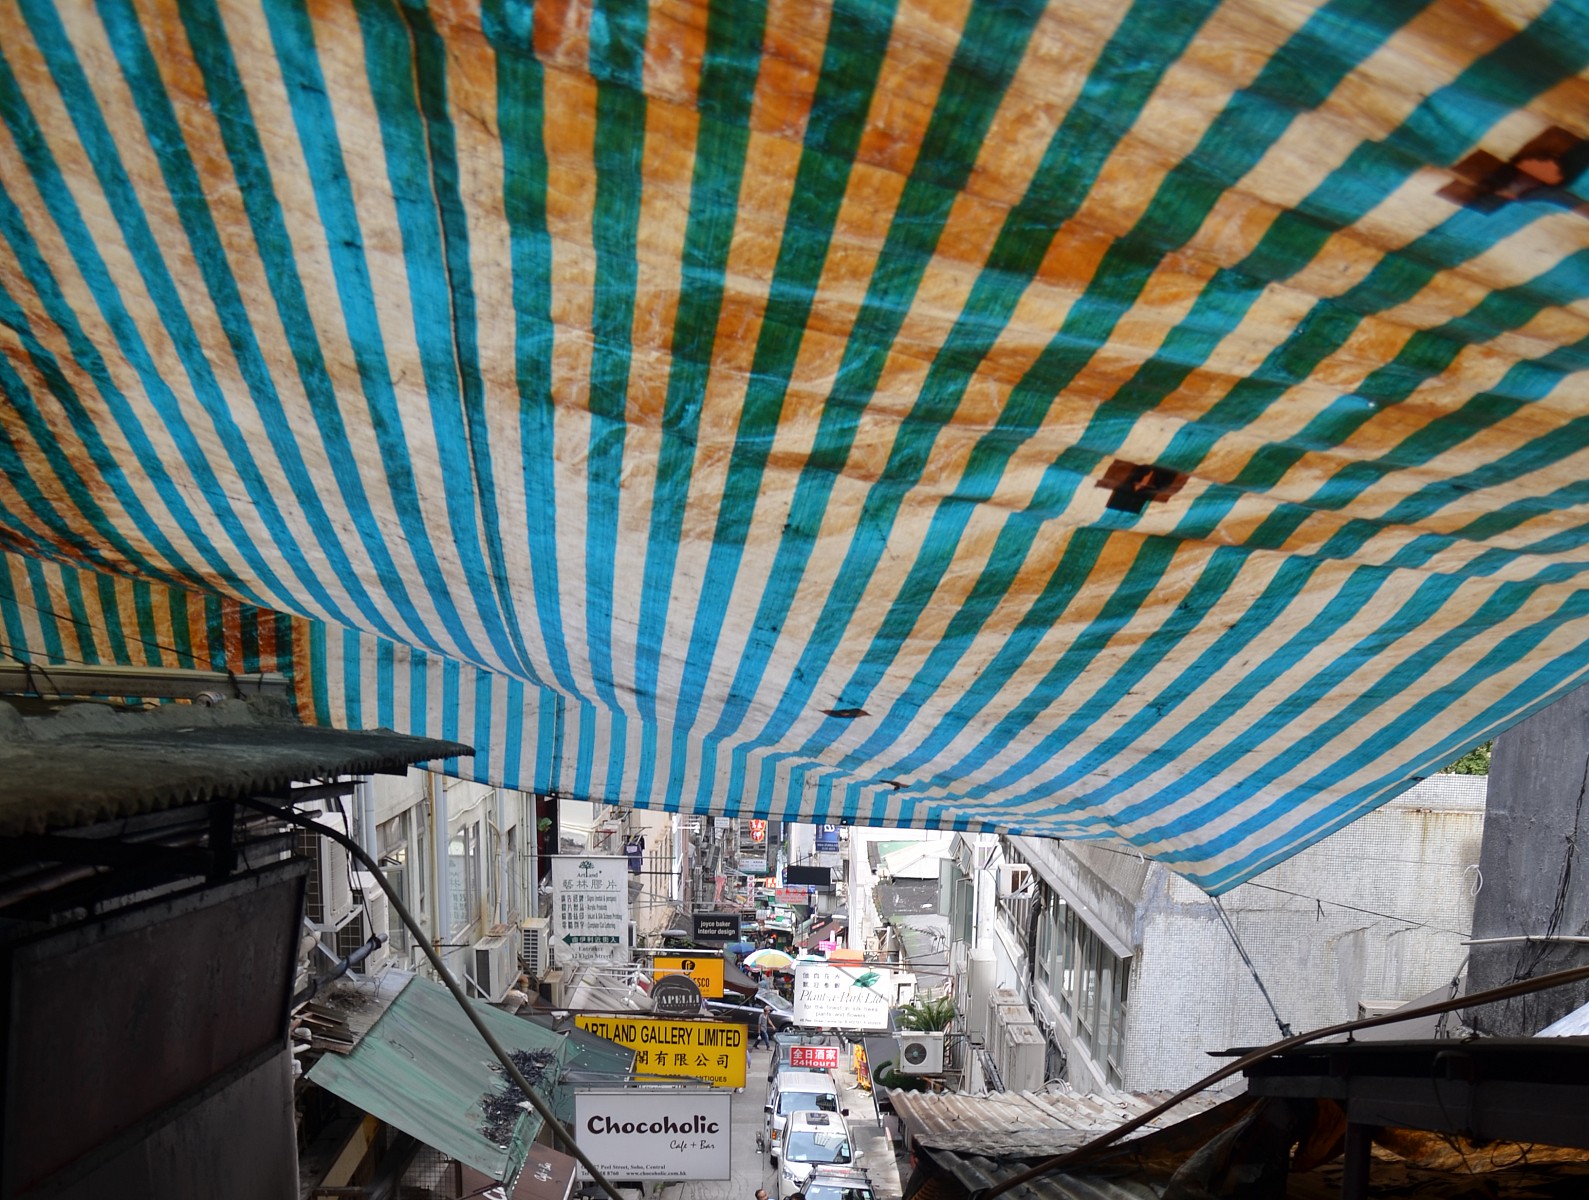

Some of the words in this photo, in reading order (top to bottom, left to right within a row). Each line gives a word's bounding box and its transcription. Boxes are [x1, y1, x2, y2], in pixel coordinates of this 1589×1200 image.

[640, 1026, 693, 1045] GALLERY
[698, 1028, 740, 1047] LIMITED
[588, 1115, 719, 1134] Chocoholic
[670, 1140, 687, 1152] Cafe
[700, 1140, 715, 1149] Bar
